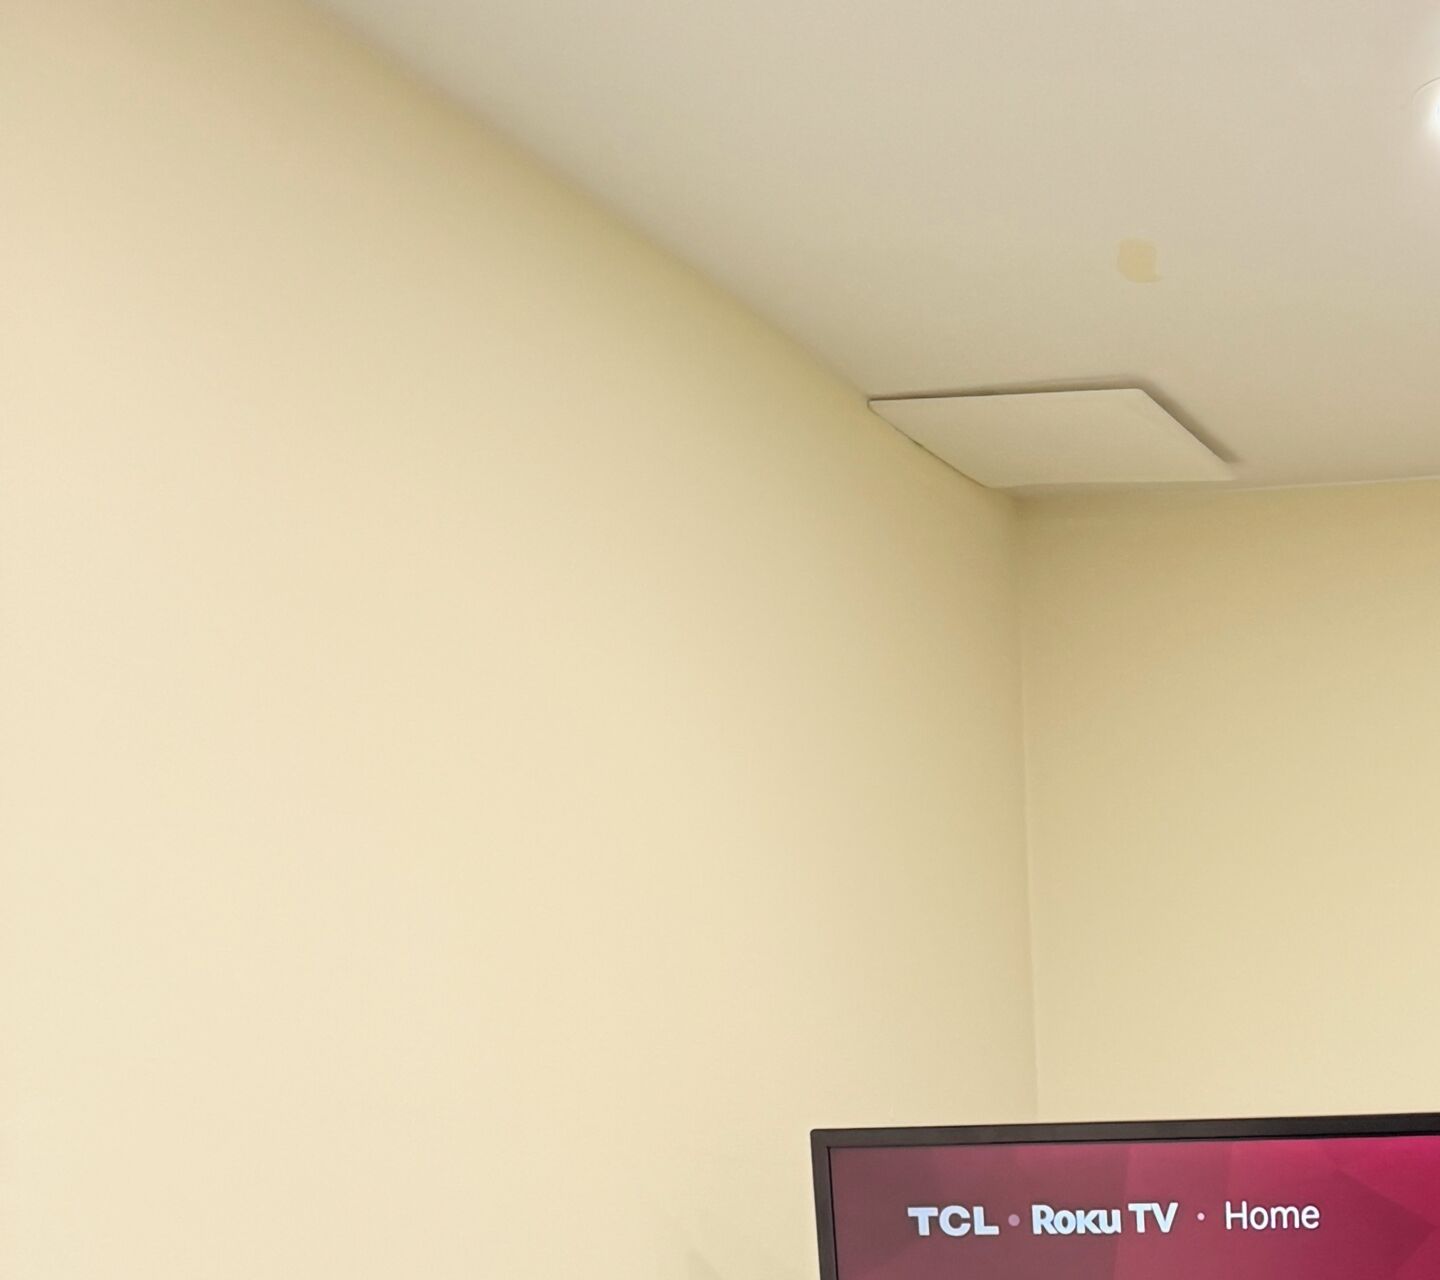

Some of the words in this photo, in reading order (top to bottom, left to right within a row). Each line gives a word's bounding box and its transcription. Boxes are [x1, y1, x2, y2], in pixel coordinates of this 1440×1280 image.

[907, 1206, 1000, 1237] TCL
[1031, 1204, 1122, 1236] Roku
[1128, 1202, 1179, 1234] TV
[1224, 1200, 1321, 1231] Home
